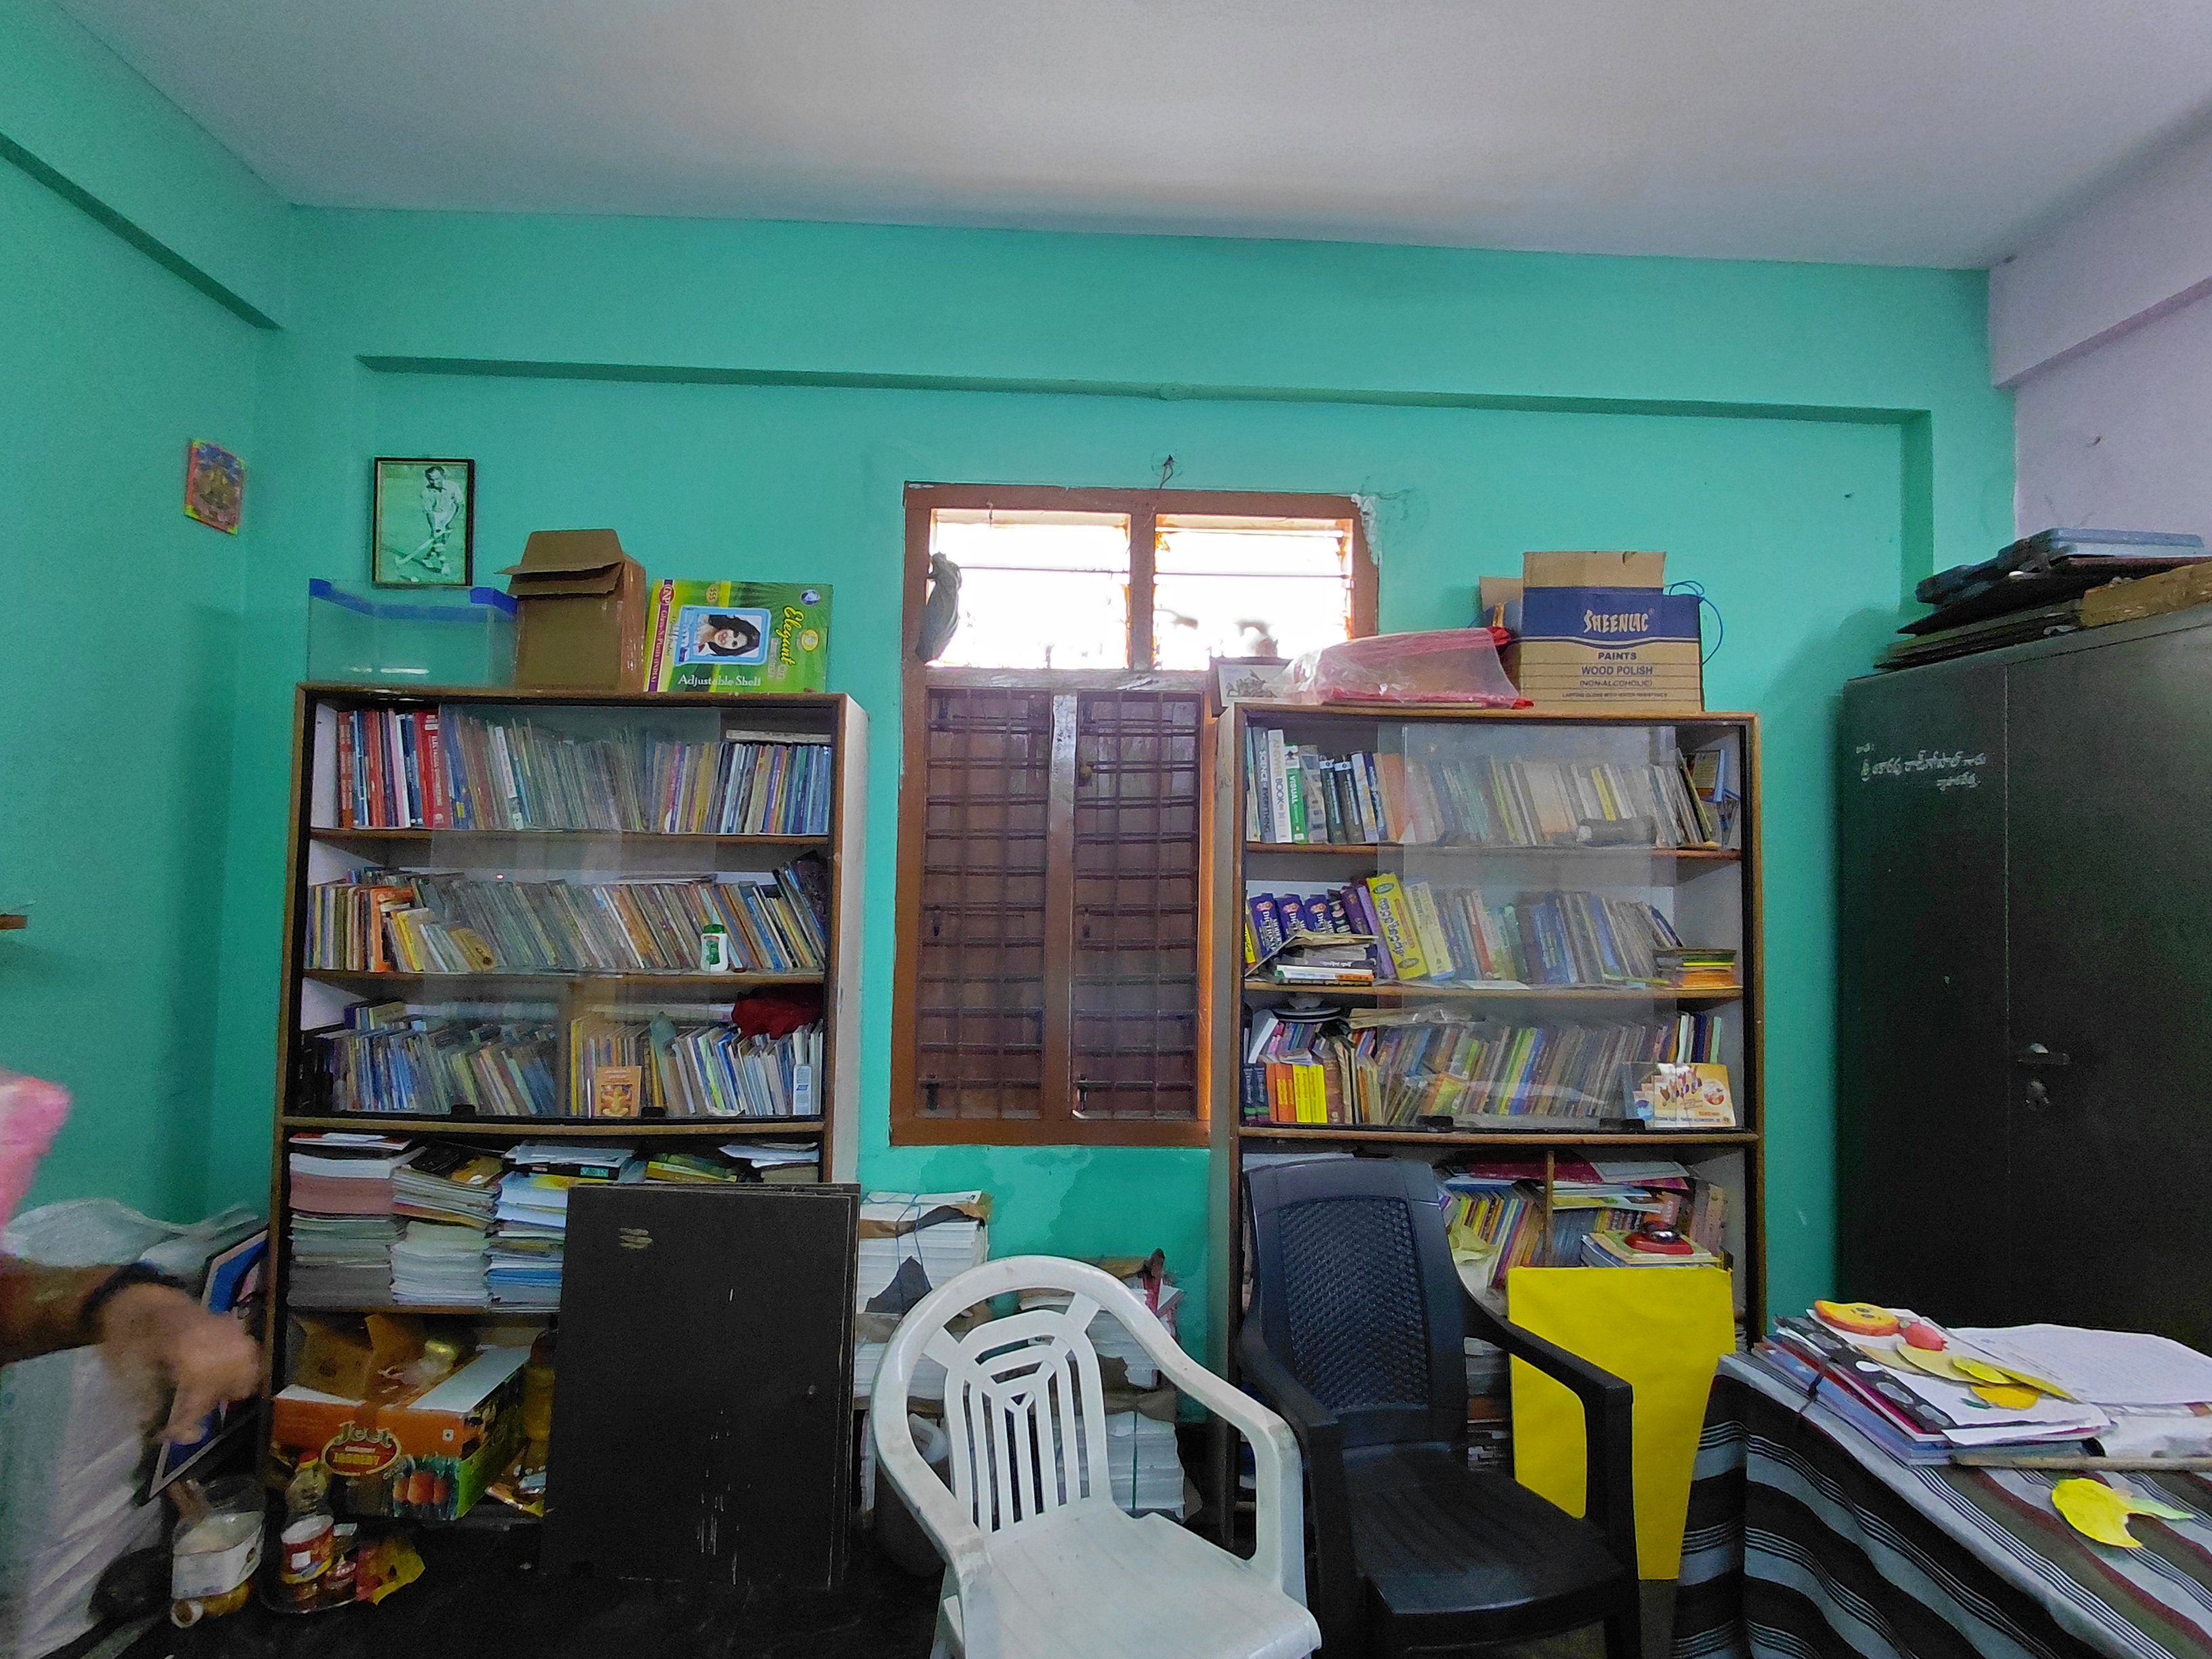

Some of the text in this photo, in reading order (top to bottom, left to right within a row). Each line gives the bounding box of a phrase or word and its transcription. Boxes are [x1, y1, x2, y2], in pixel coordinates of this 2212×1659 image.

[661, 586, 672, 604] GNP
[1583, 609, 1649, 633] SHEENLAC
[775, 606, 805, 666] Elegant
[1598, 652, 1637, 660] PAINTS
[678, 674, 735, 687] Adjustable
[1581, 665, 1653, 675] WOOD POLISH
[1275, 778, 1285, 804] BOOK
[1290, 775, 1299, 804] VISUAL
